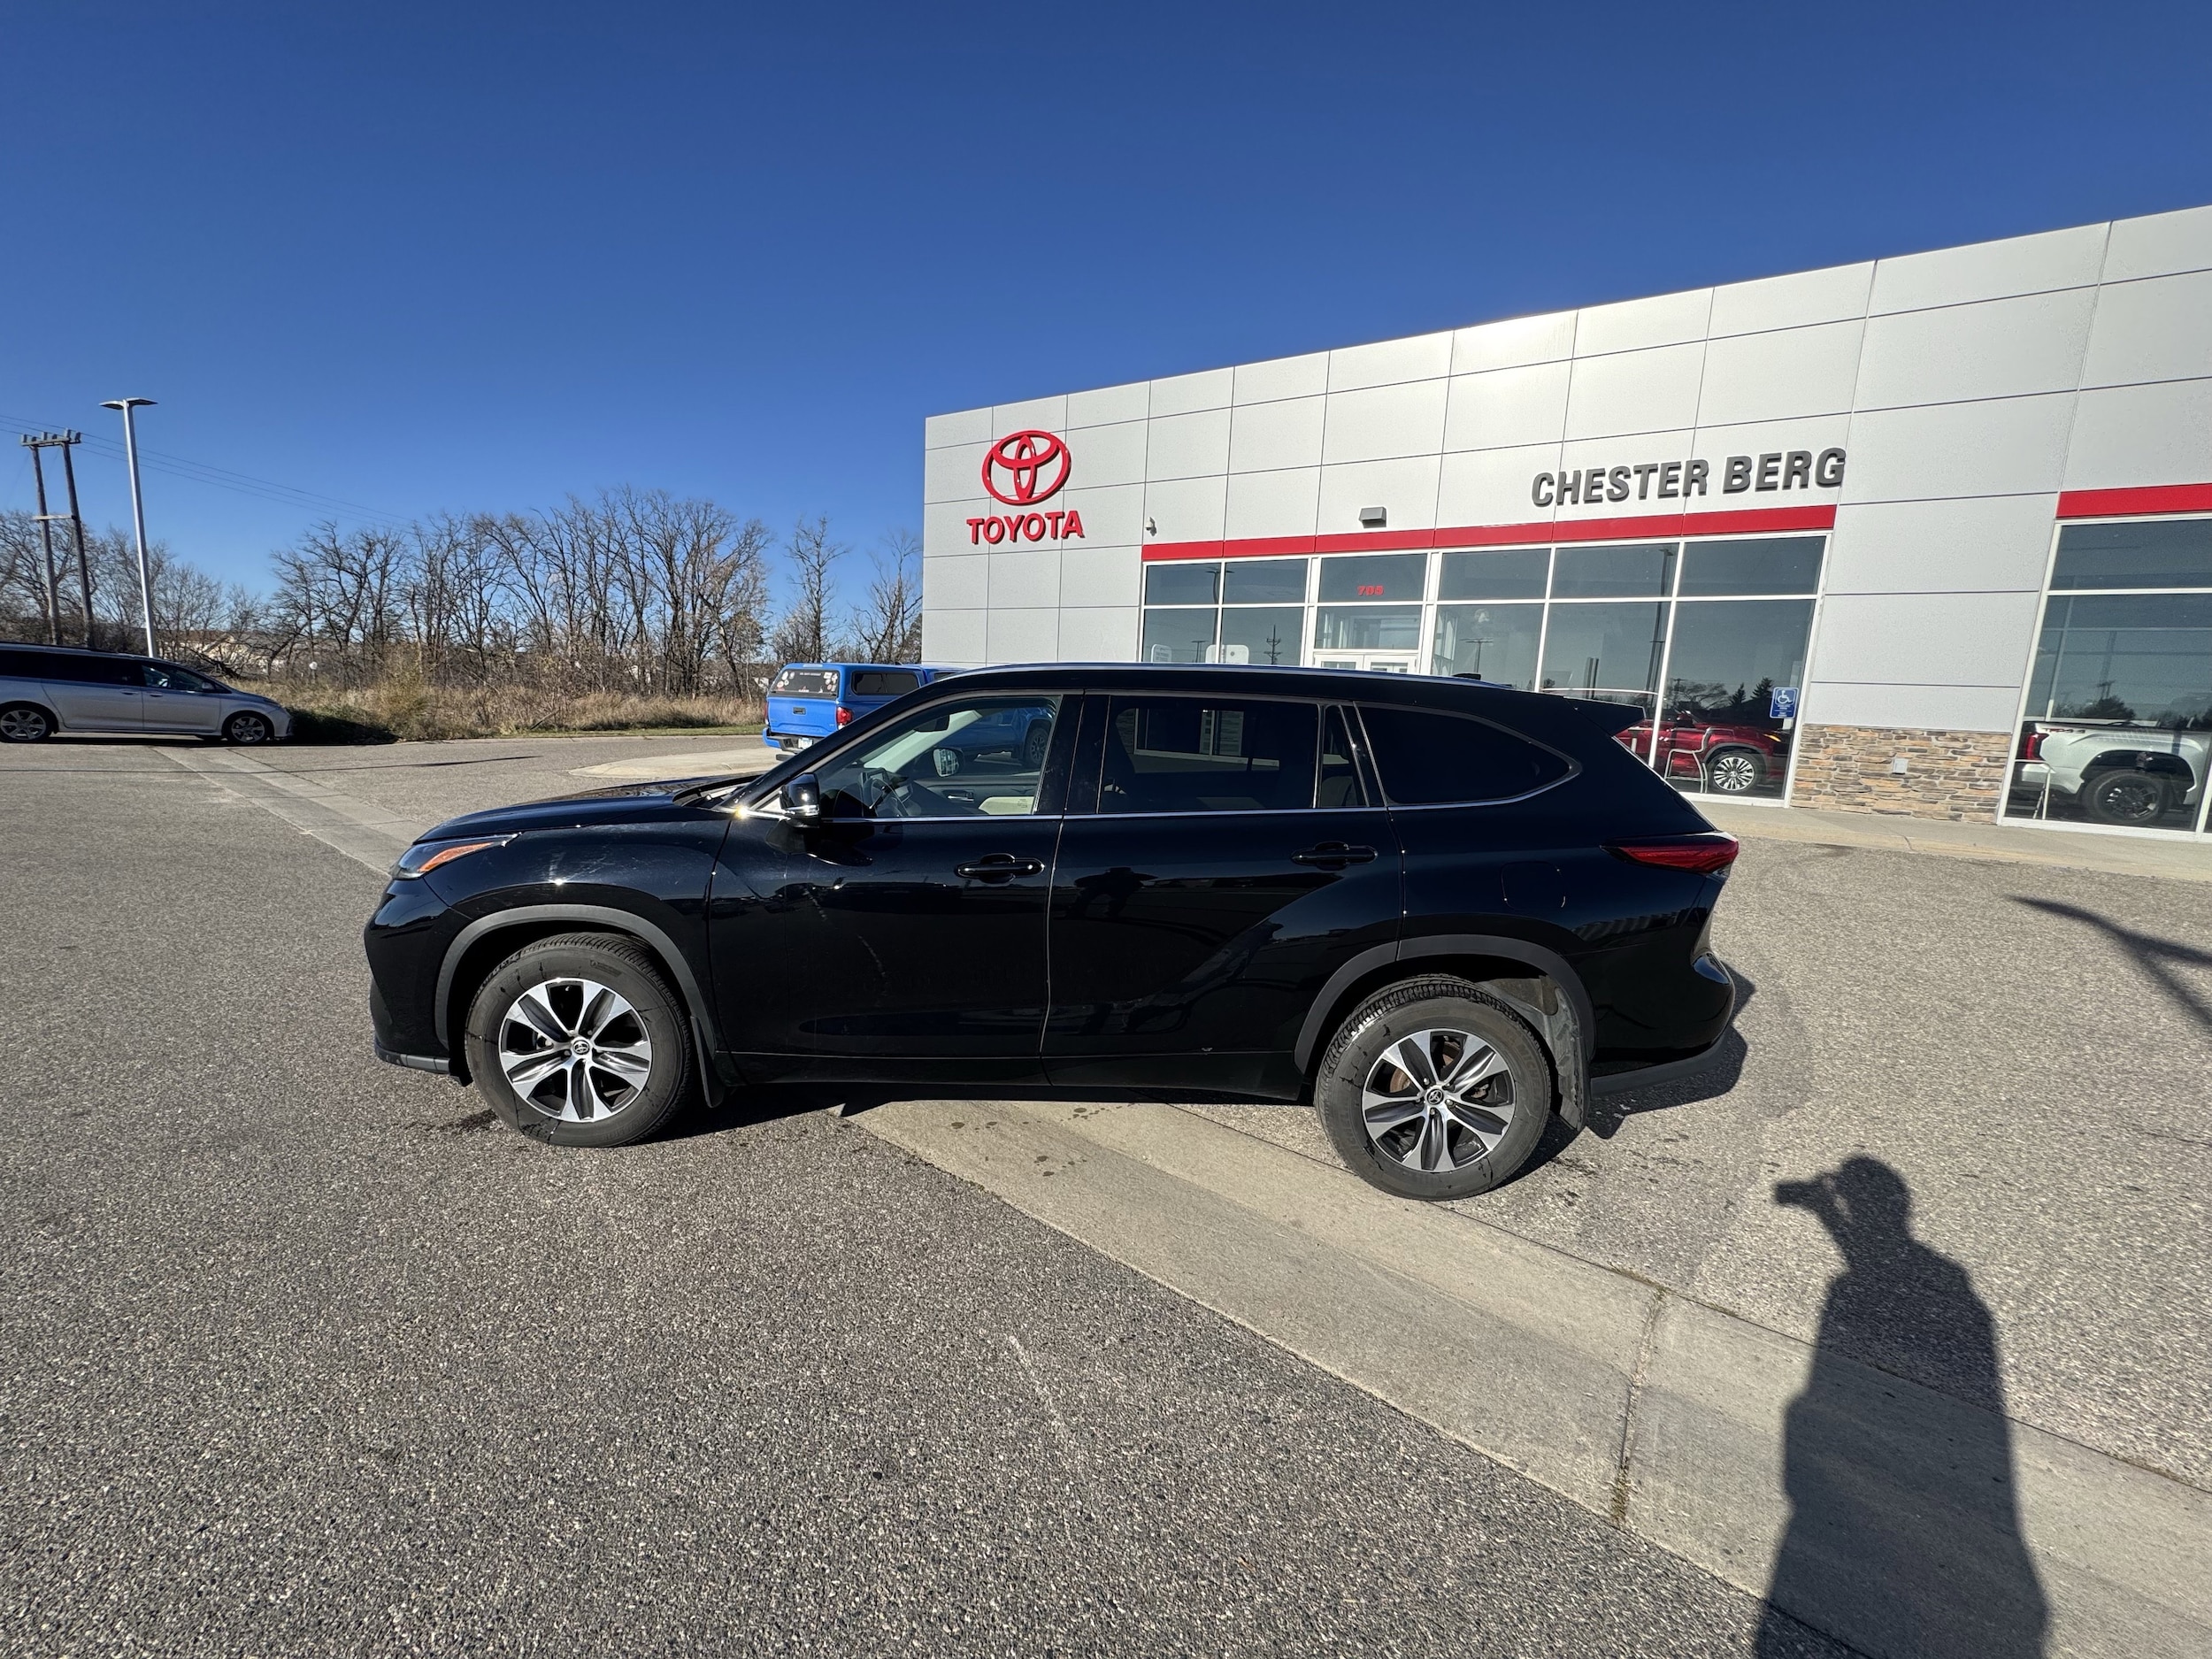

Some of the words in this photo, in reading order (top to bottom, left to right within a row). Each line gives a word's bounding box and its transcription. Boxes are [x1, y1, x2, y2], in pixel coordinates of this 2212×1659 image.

[1532, 458, 1709, 507] CHESTER
[1723, 447, 1847, 495] BERG
[966, 510, 1085, 545] TOYOTA
